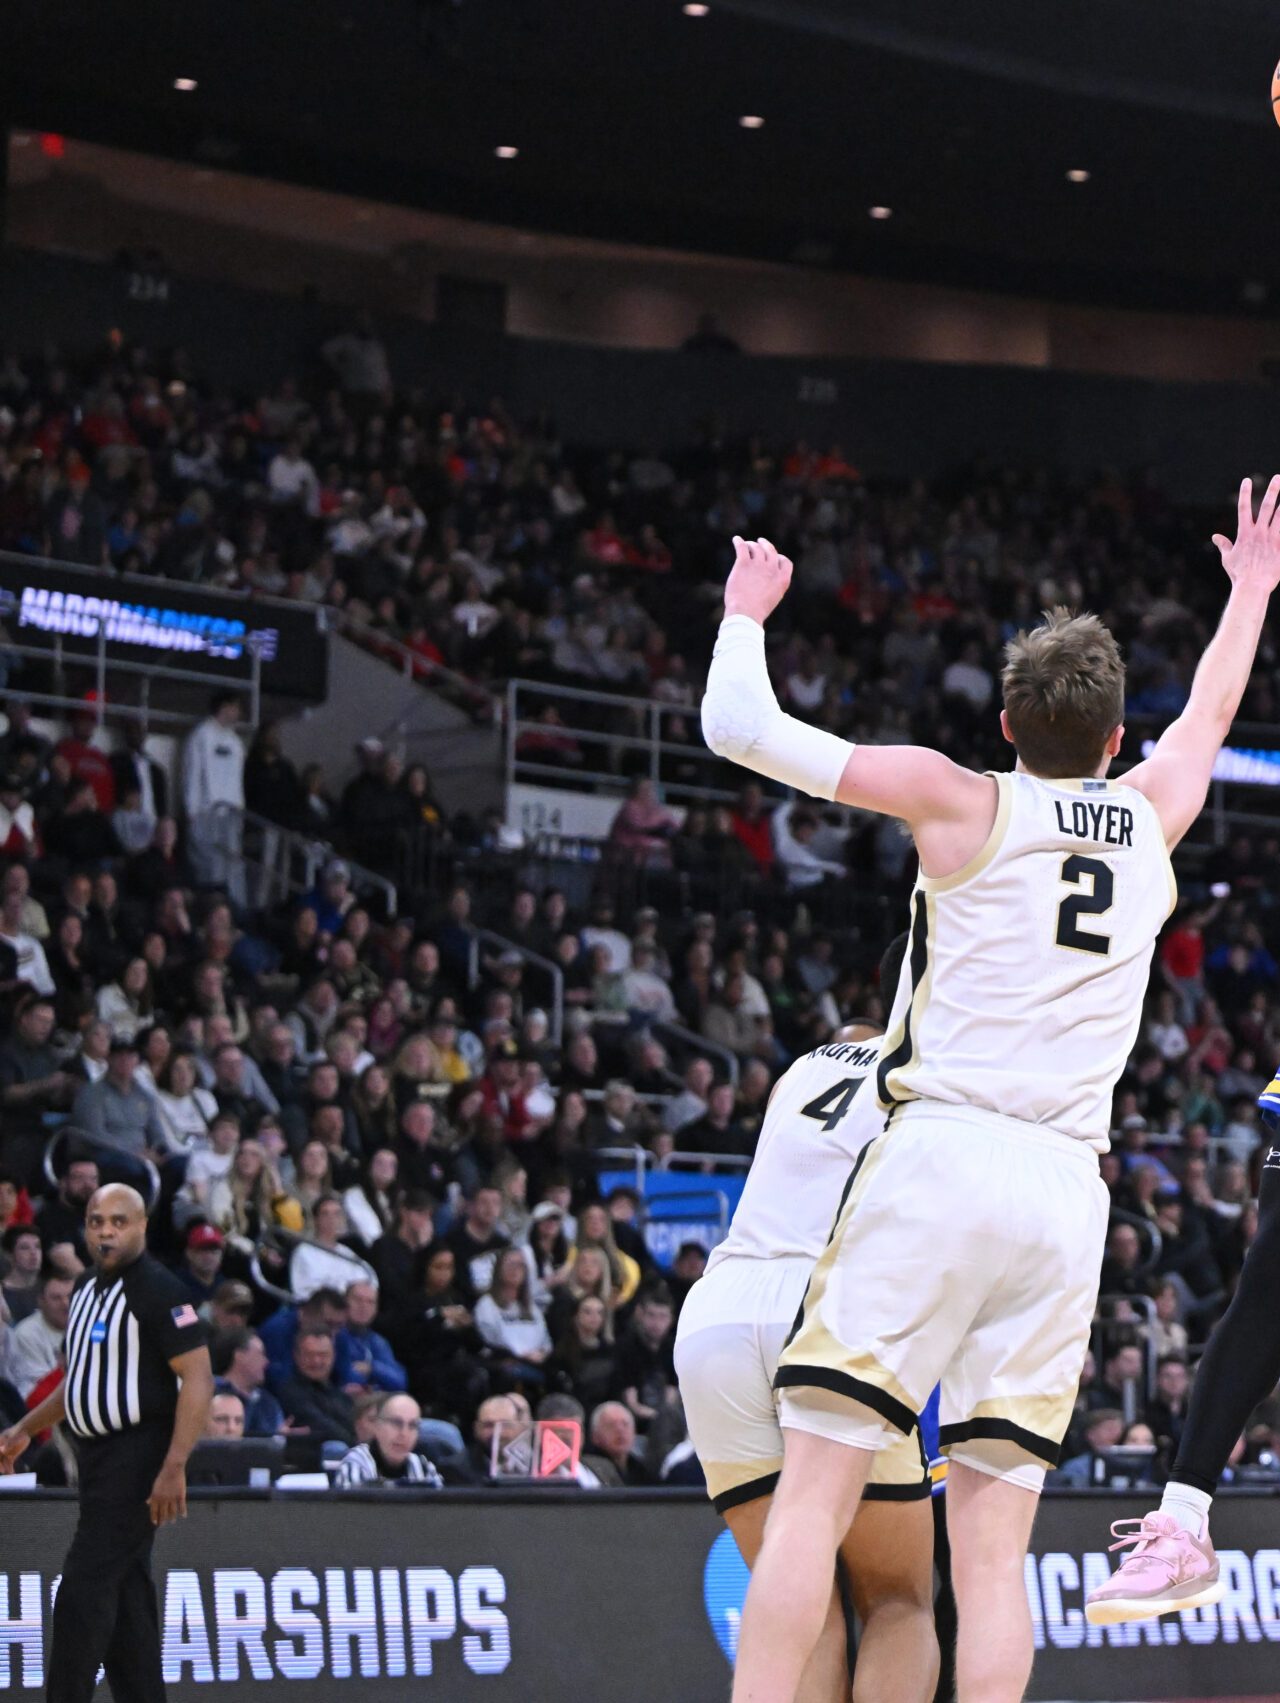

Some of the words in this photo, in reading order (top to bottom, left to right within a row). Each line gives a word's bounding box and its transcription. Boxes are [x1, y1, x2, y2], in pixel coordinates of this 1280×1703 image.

[1054, 800, 1134, 848] LOYER
[1056, 853, 1115, 957] 2
[799, 1075, 867, 1132] 4
[0, 1565, 512, 1689] HARSHIPS
